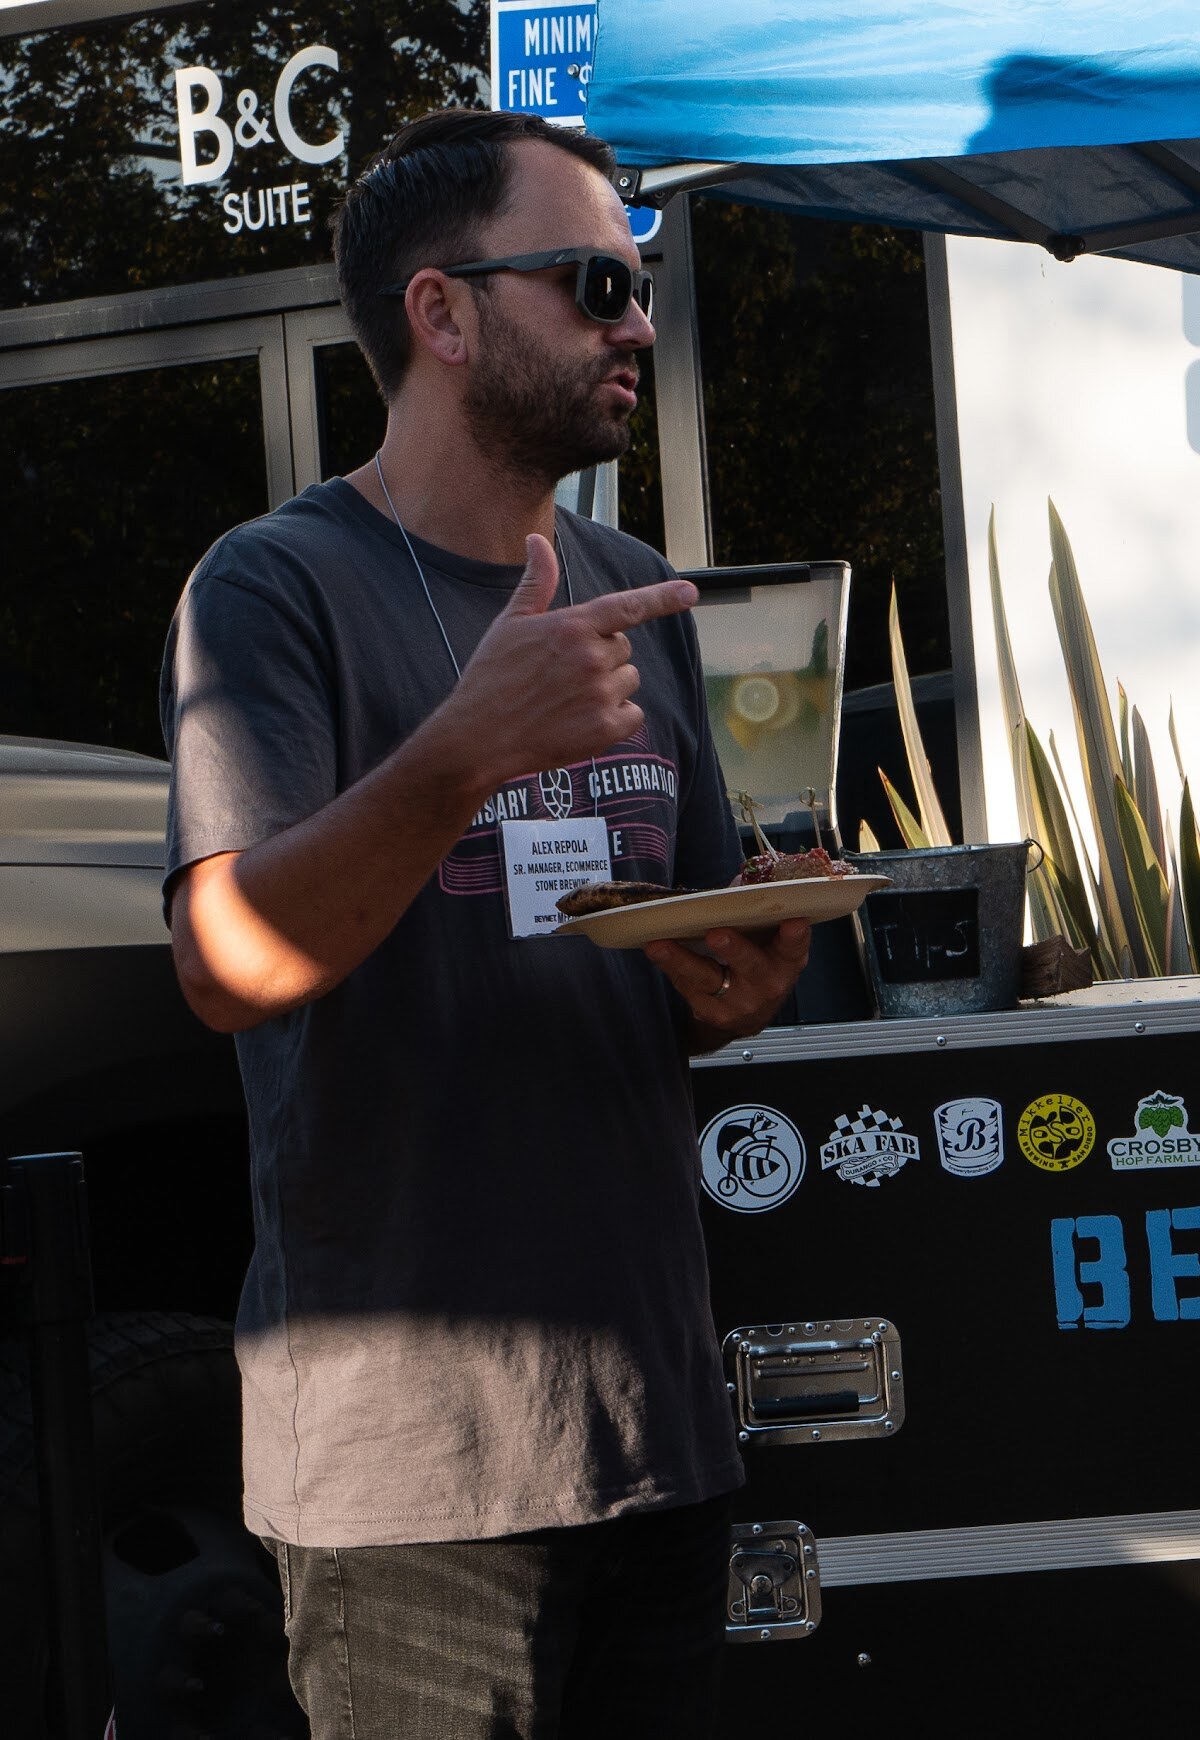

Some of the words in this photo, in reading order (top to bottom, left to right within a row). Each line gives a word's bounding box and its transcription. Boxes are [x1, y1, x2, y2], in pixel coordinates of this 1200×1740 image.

[524, 14, 598, 57] MINIM
[508, 66, 558, 108] FINE
[175, 45, 345, 187] B&C
[223, 182, 311, 235] SUITE
[588, 763, 678, 800] CELEBRATIO
[532, 839, 554, 856] ALEX
[554, 838, 589, 854] REPOLA
[513, 863, 527, 877] SR.
[527, 860, 566, 875] MANAGER,
[565, 859, 608, 873] ECOMMERCE
[535, 879, 558, 892] STONE
[1019, 1095, 1092, 1138] Mikkeller
[823, 1136, 867, 1166] SKA
[874, 1135, 917, 1155] FAB
[954, 1117, 987, 1153] B
[1022, 1141, 1056, 1169] BREWING
[1072, 1149, 1088, 1164] SAN
[1083, 1127, 1094, 1150] DIEGO
[845, 1159, 878, 1175] DURANGO
[882, 1155, 894, 1163] CO
[1116, 1156, 1144, 1166] HOP
